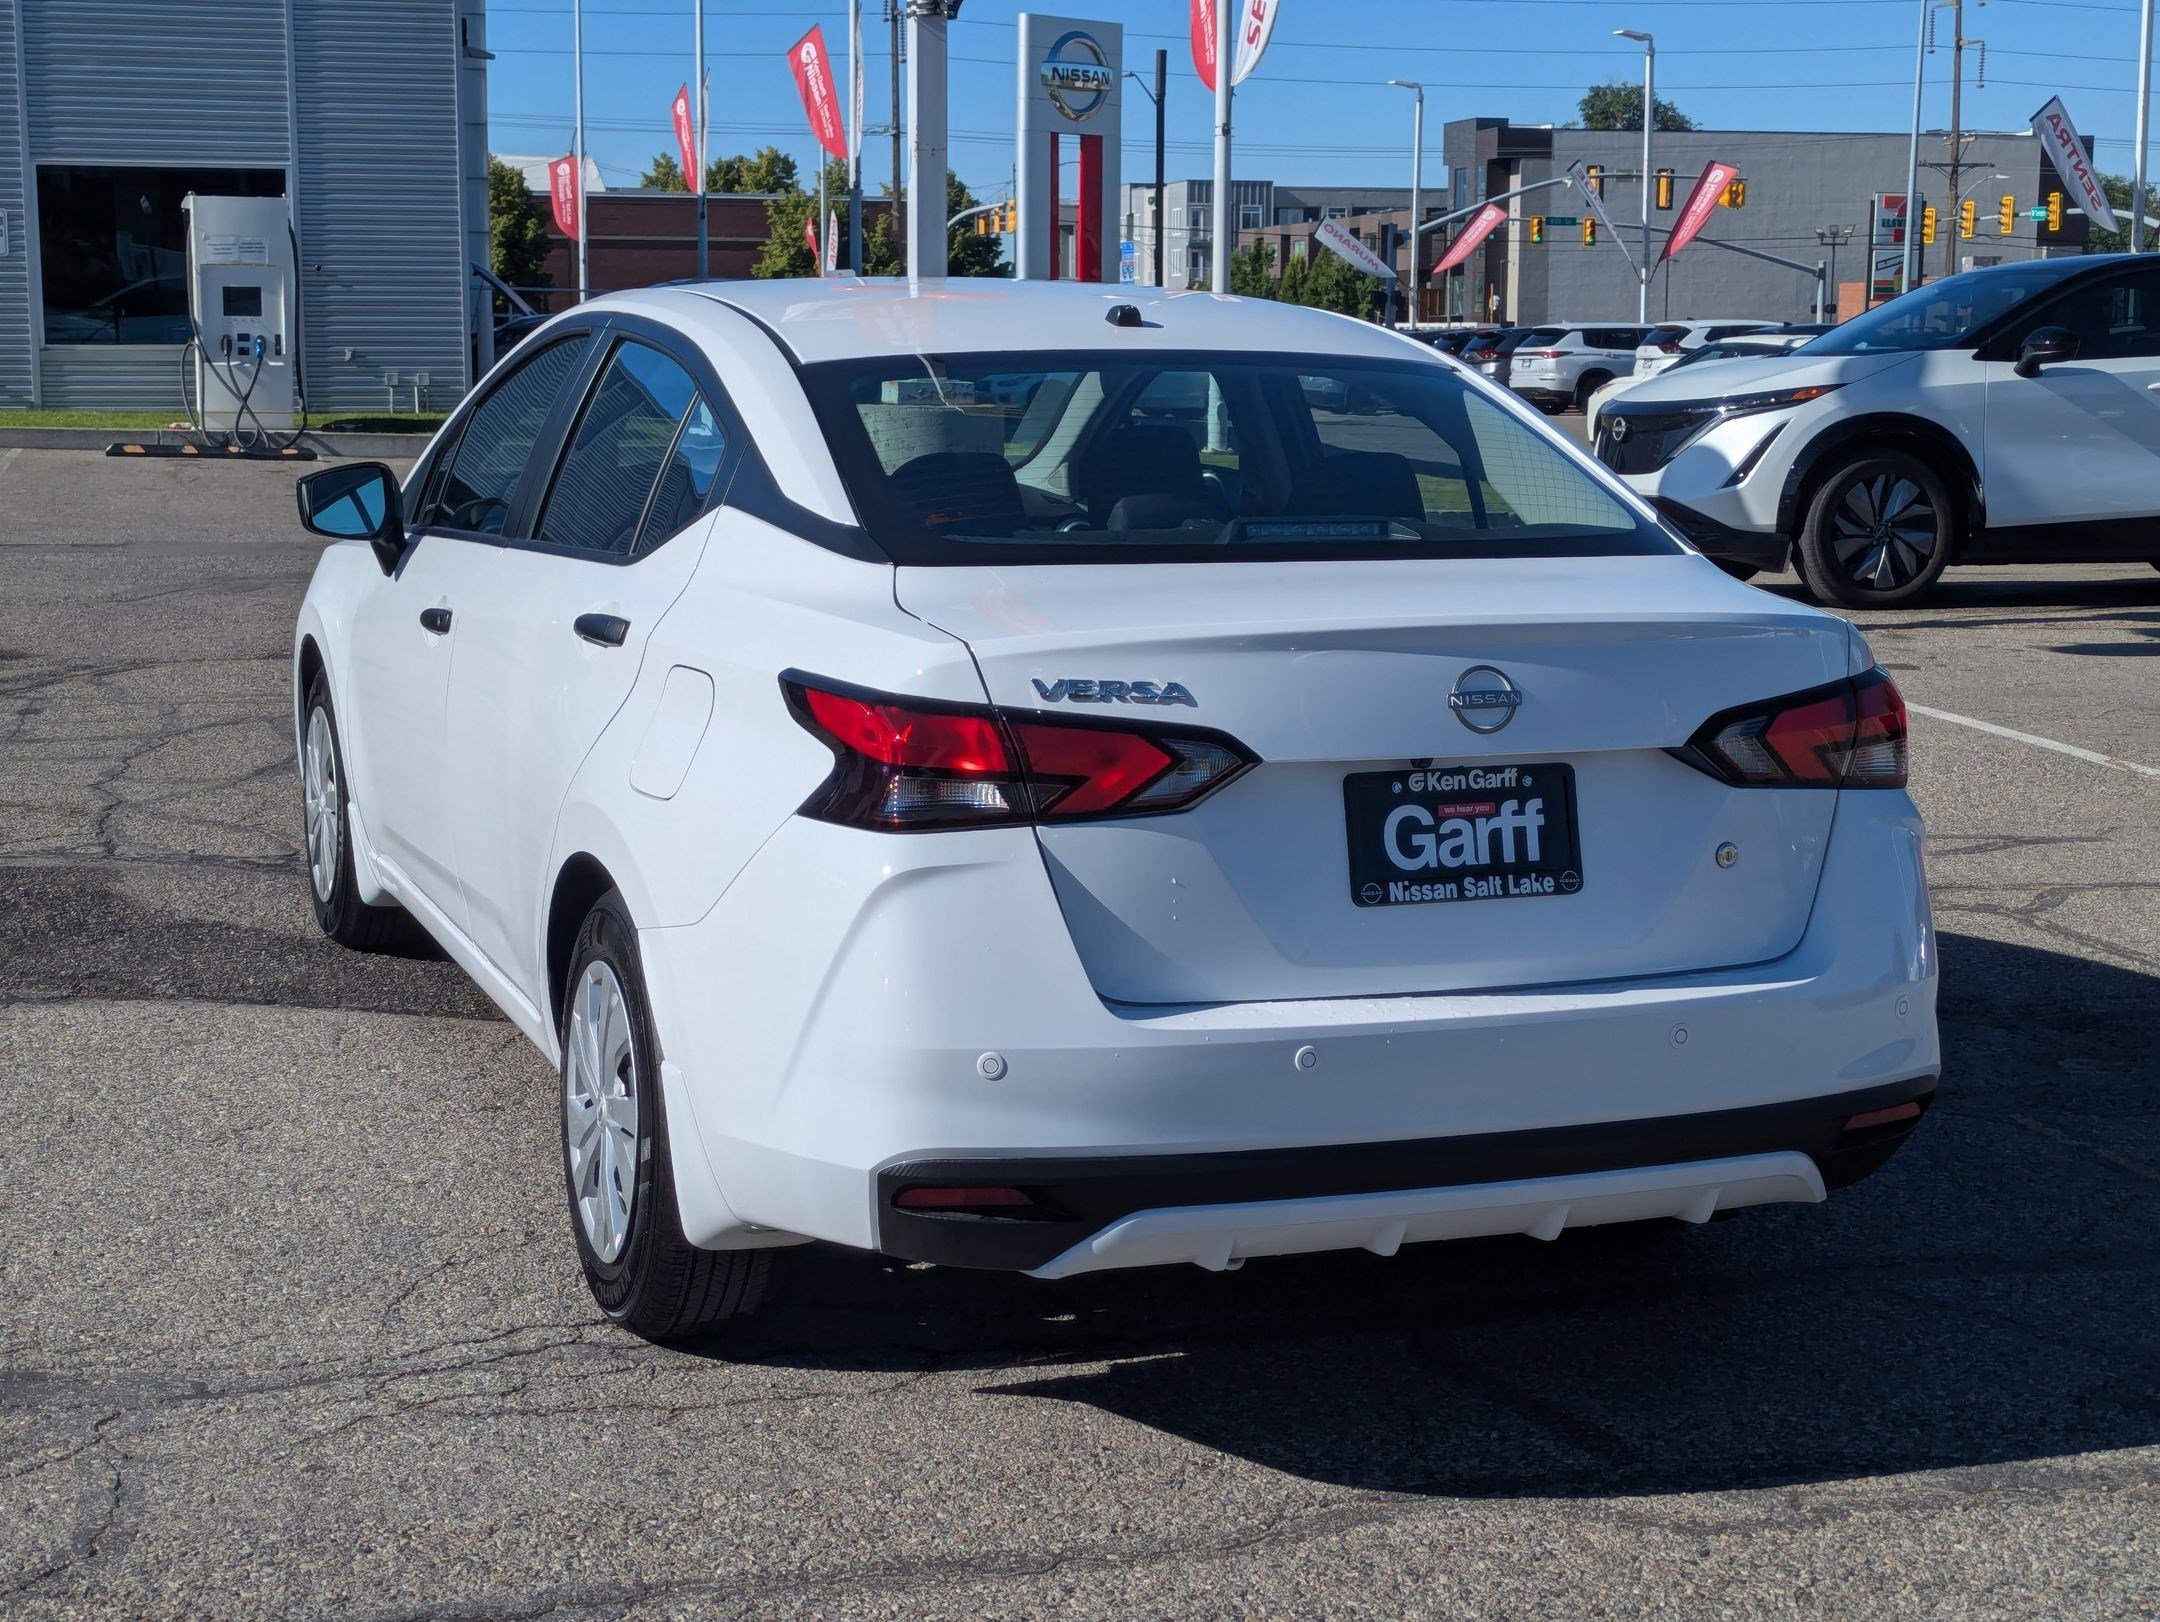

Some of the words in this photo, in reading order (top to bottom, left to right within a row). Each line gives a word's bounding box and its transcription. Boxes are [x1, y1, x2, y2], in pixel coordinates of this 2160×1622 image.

[804, 63, 821, 107] Nissan
[1052, 67, 1109, 85] NISSAN
[1882, 219, 1909, 228] ELEV
[1031, 678, 1199, 708] VERSA
[1450, 693, 1520, 706] NISSAN
[1427, 771, 1466, 791] Ken
[1468, 768, 1518, 788] Garff
[1456, 805, 1473, 813] hear
[1475, 804, 1490, 813] you
[1383, 798, 1545, 871] Garff
[1388, 881, 1458, 902] Nissan
[1463, 876, 1502, 898] Salt
[1509, 873, 1555, 895] Lake
